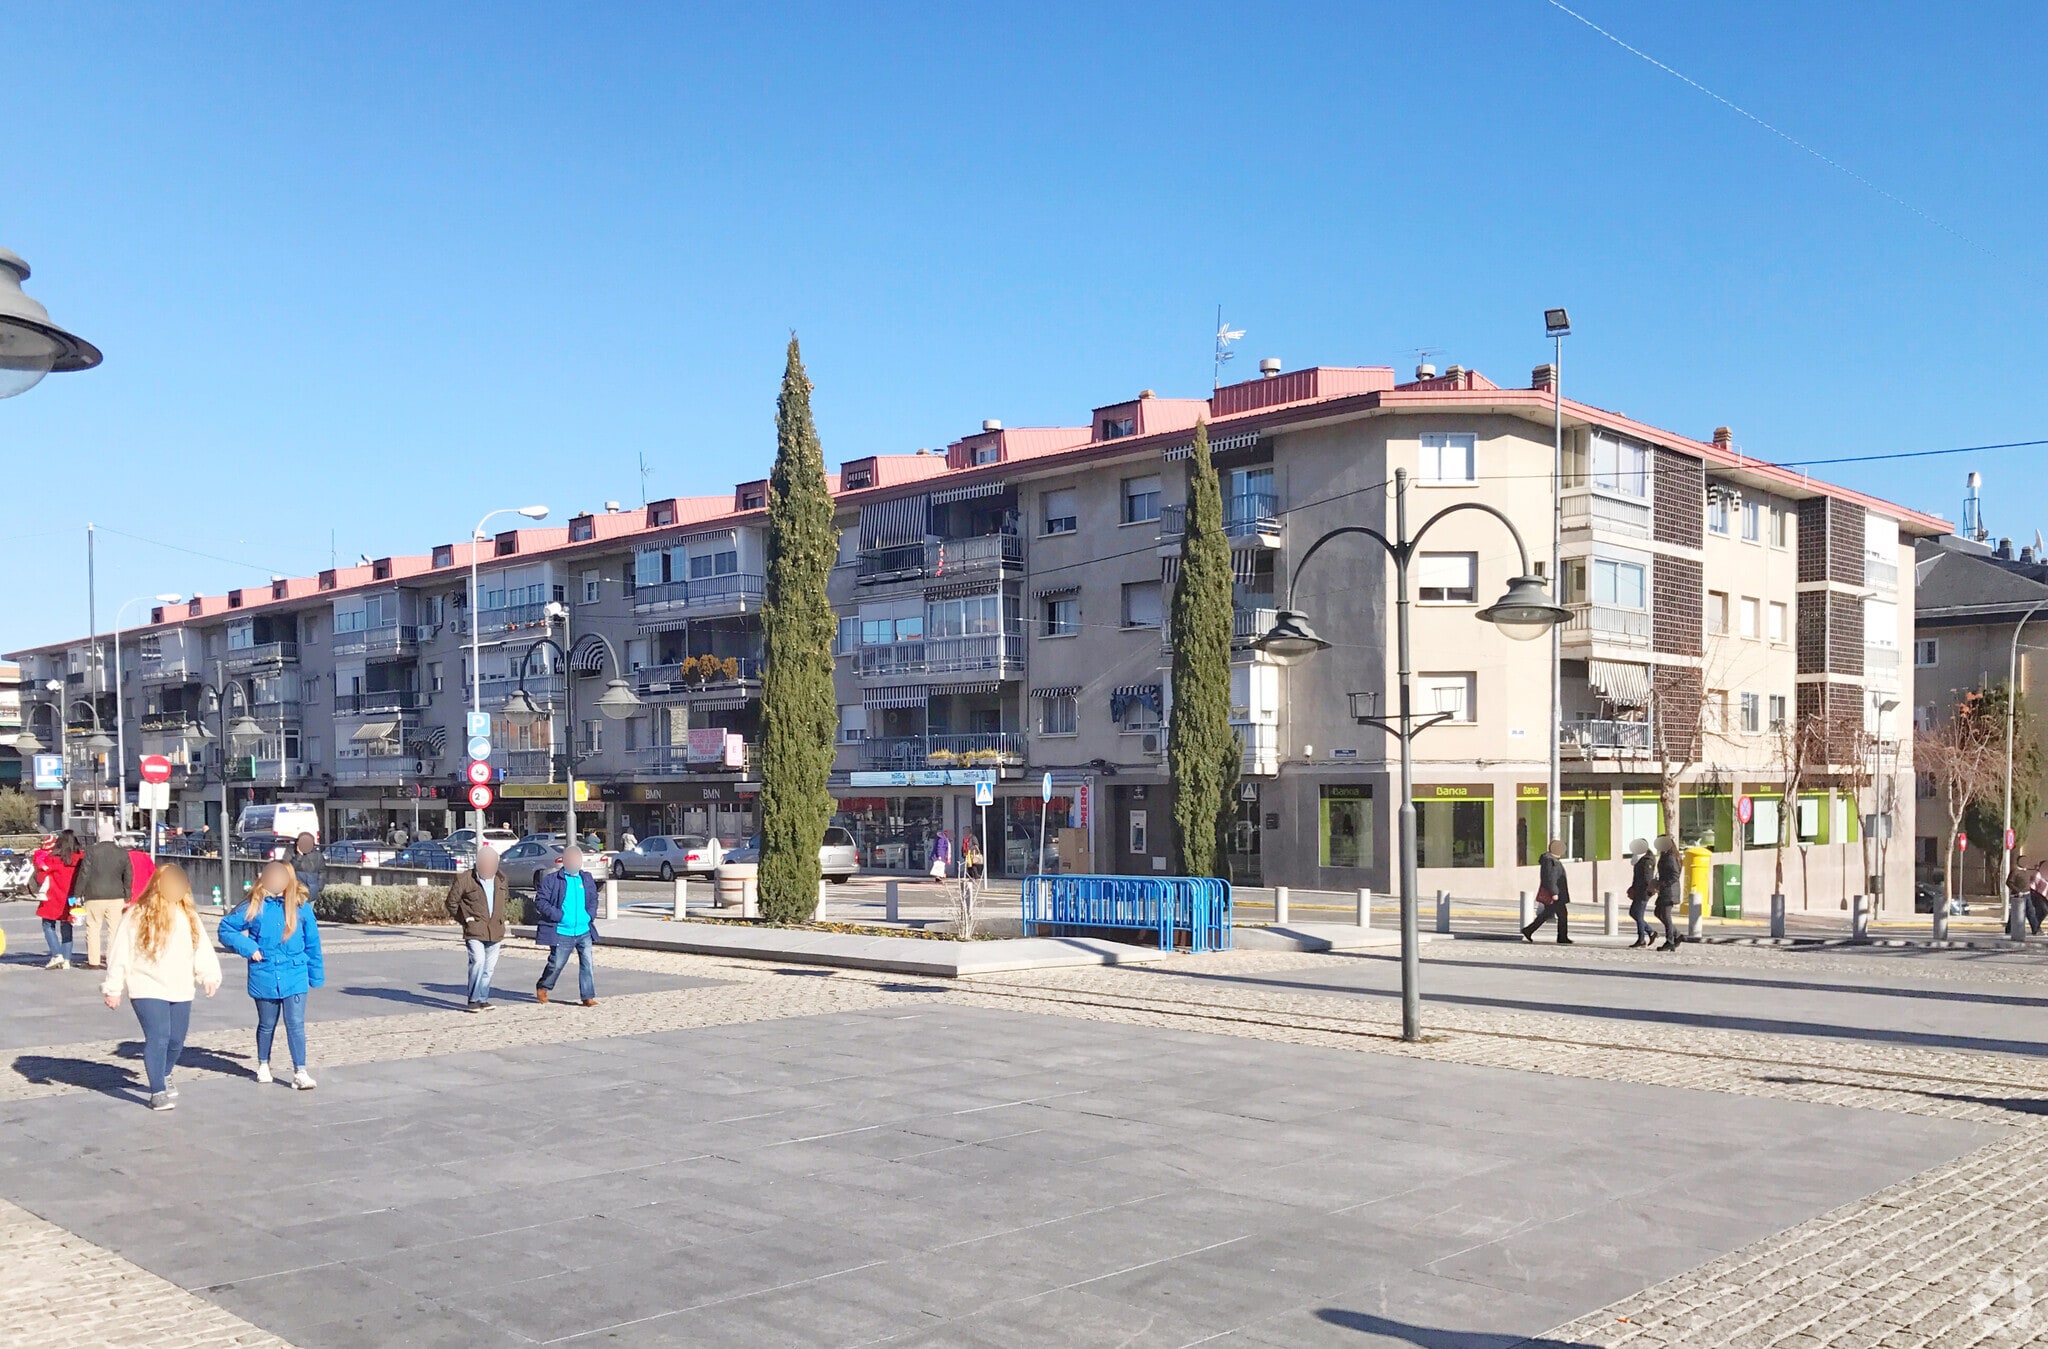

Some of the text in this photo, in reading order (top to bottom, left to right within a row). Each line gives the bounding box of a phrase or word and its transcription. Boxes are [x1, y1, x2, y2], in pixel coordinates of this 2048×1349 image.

[472, 714, 486, 734] P
[40, 758, 58, 776] P
[645, 789, 662, 800] BMN
[702, 788, 721, 799] BMN
[1436, 786, 1468, 796] Bankia
